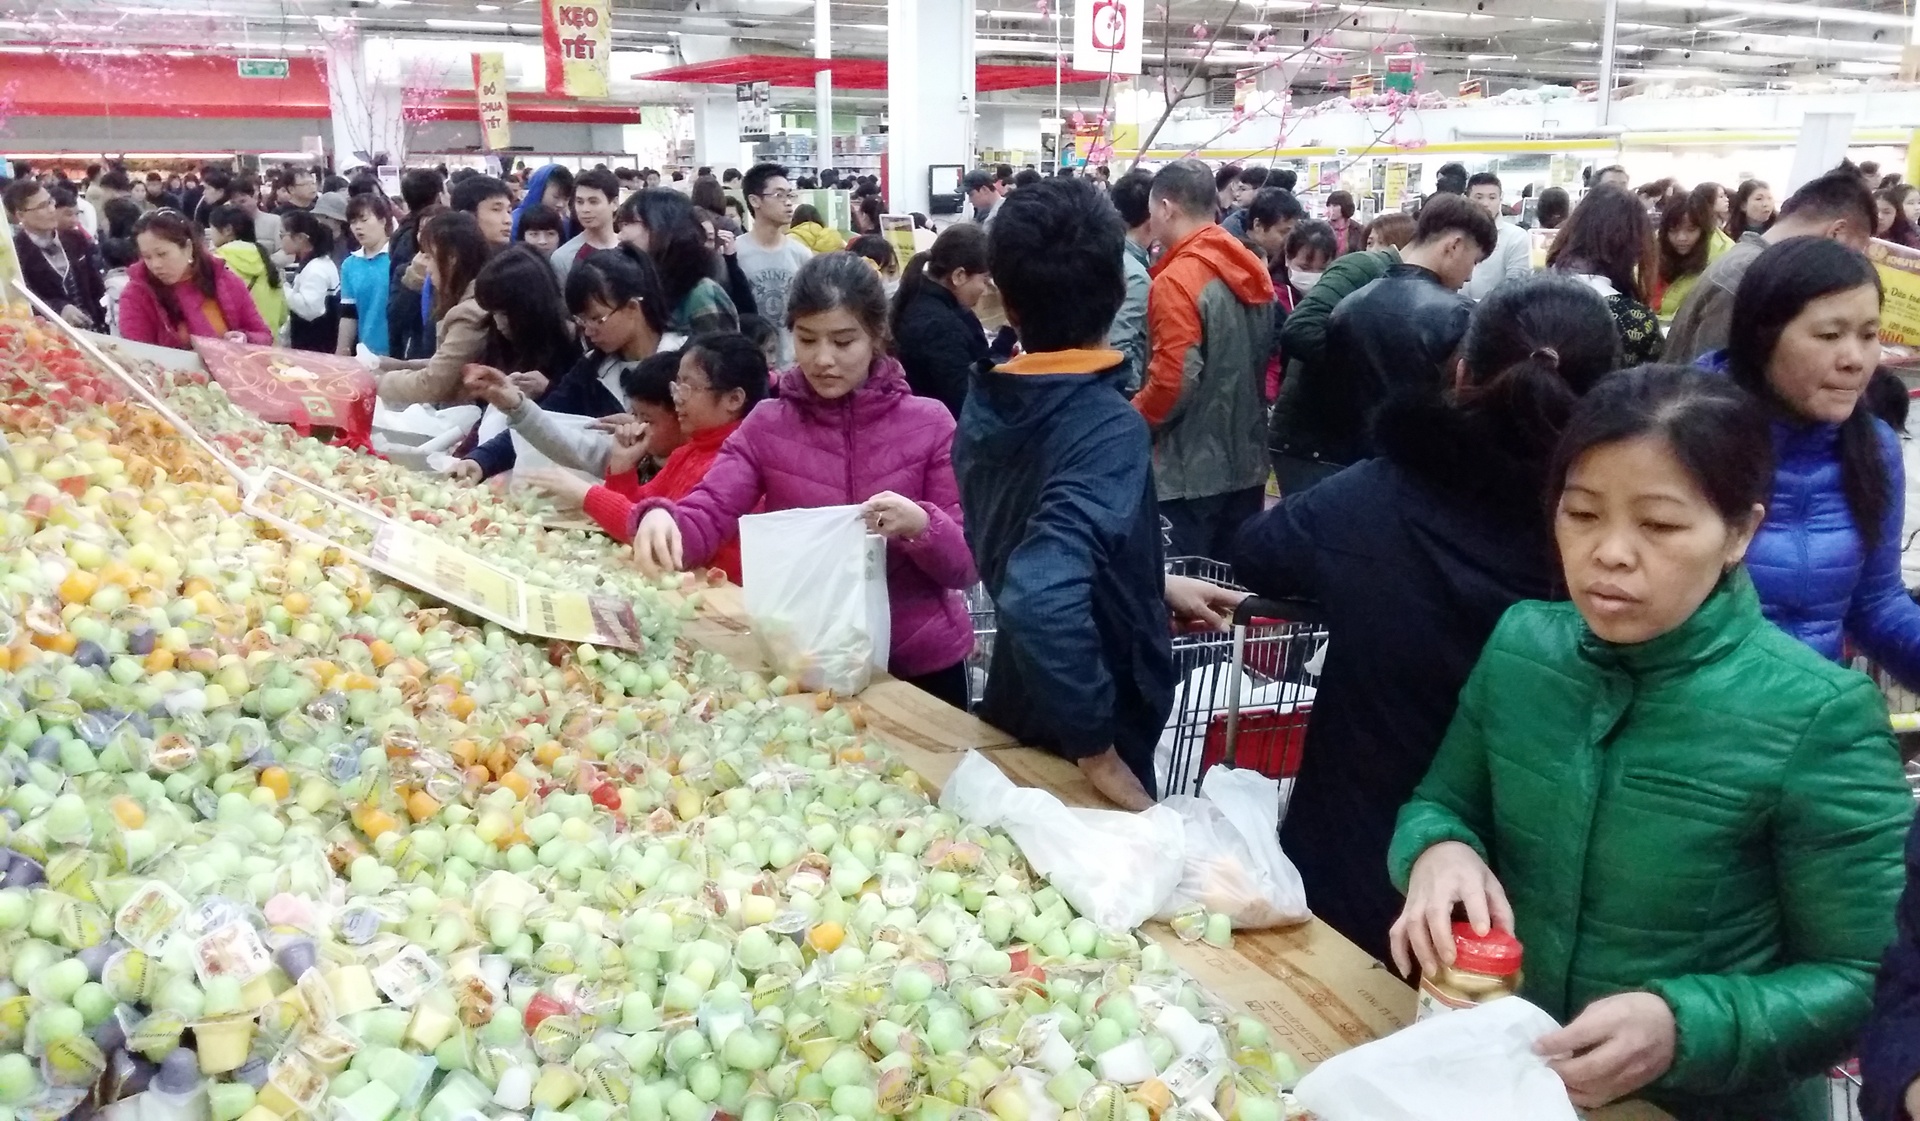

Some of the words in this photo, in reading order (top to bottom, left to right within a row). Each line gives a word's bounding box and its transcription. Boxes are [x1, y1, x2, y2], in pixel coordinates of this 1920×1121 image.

[559, 6, 598, 30] KẸO
[562, 33, 597, 59] TẾT
[486, 115, 501, 129] TẾT
